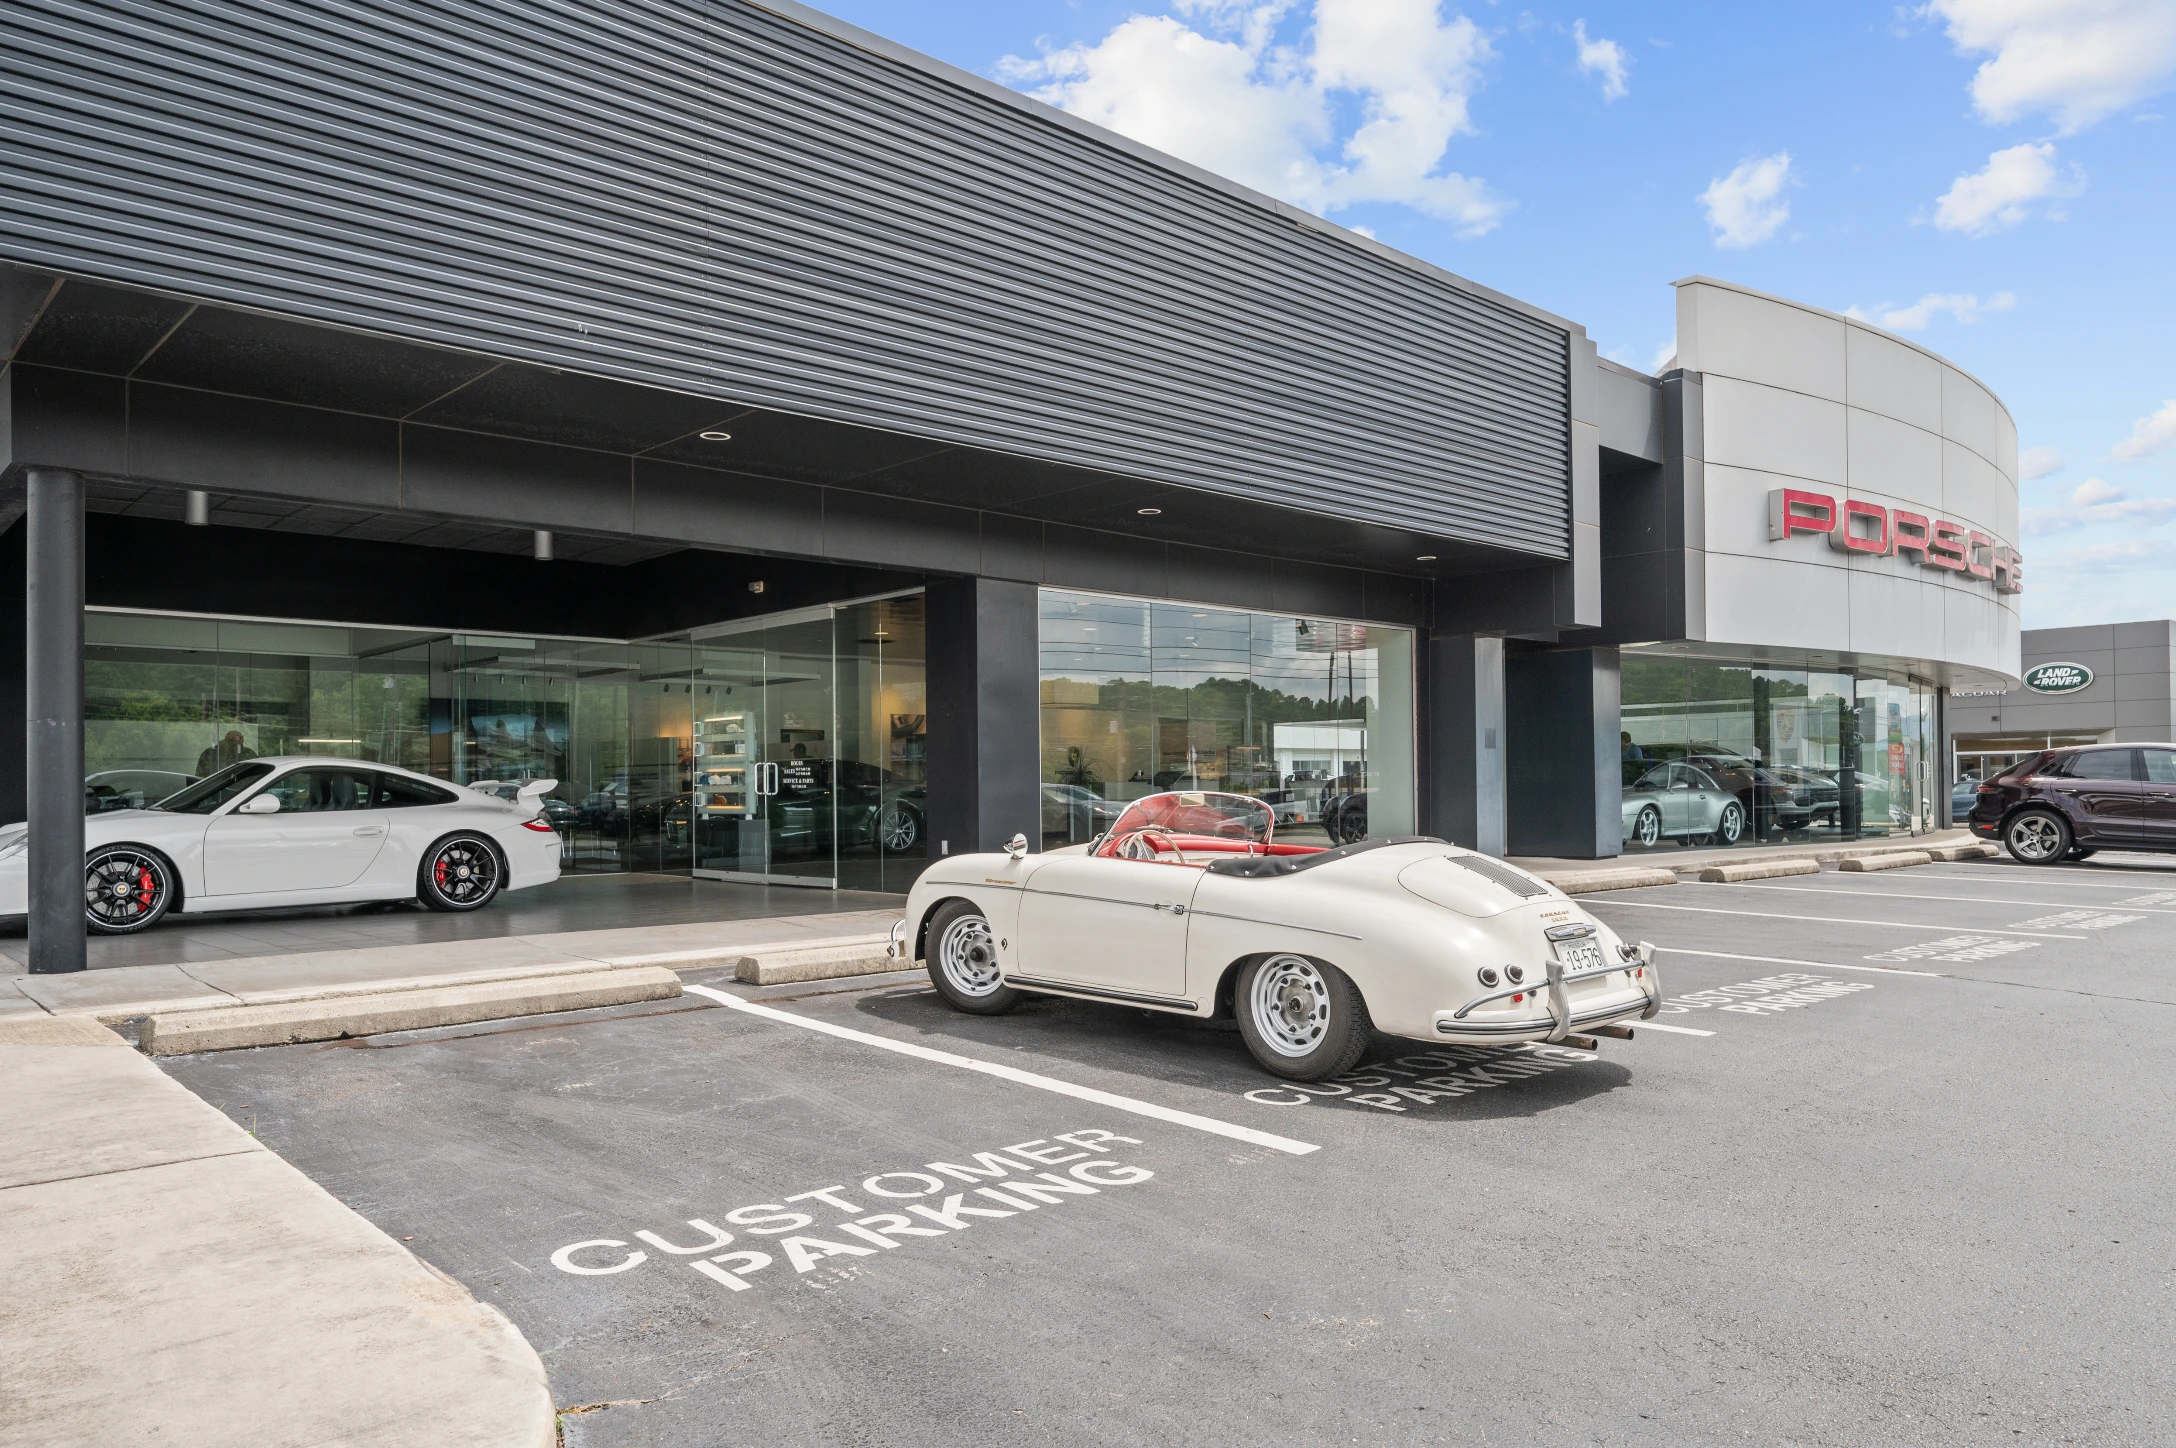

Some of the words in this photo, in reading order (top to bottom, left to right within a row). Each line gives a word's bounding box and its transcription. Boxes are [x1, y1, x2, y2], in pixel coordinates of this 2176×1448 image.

[1769, 488, 2023, 594] PORSCHE
[1950, 690, 2007, 698] AGUAR
[2037, 668, 2071, 678] LAND
[2041, 677, 2081, 687] ROVER
[1718, 981, 1875, 1016] PARKING
[1345, 1050, 1599, 1112] PARKING
[550, 1128, 1144, 1276] CUSTOMER
[690, 1160, 1155, 1292] PARKING
